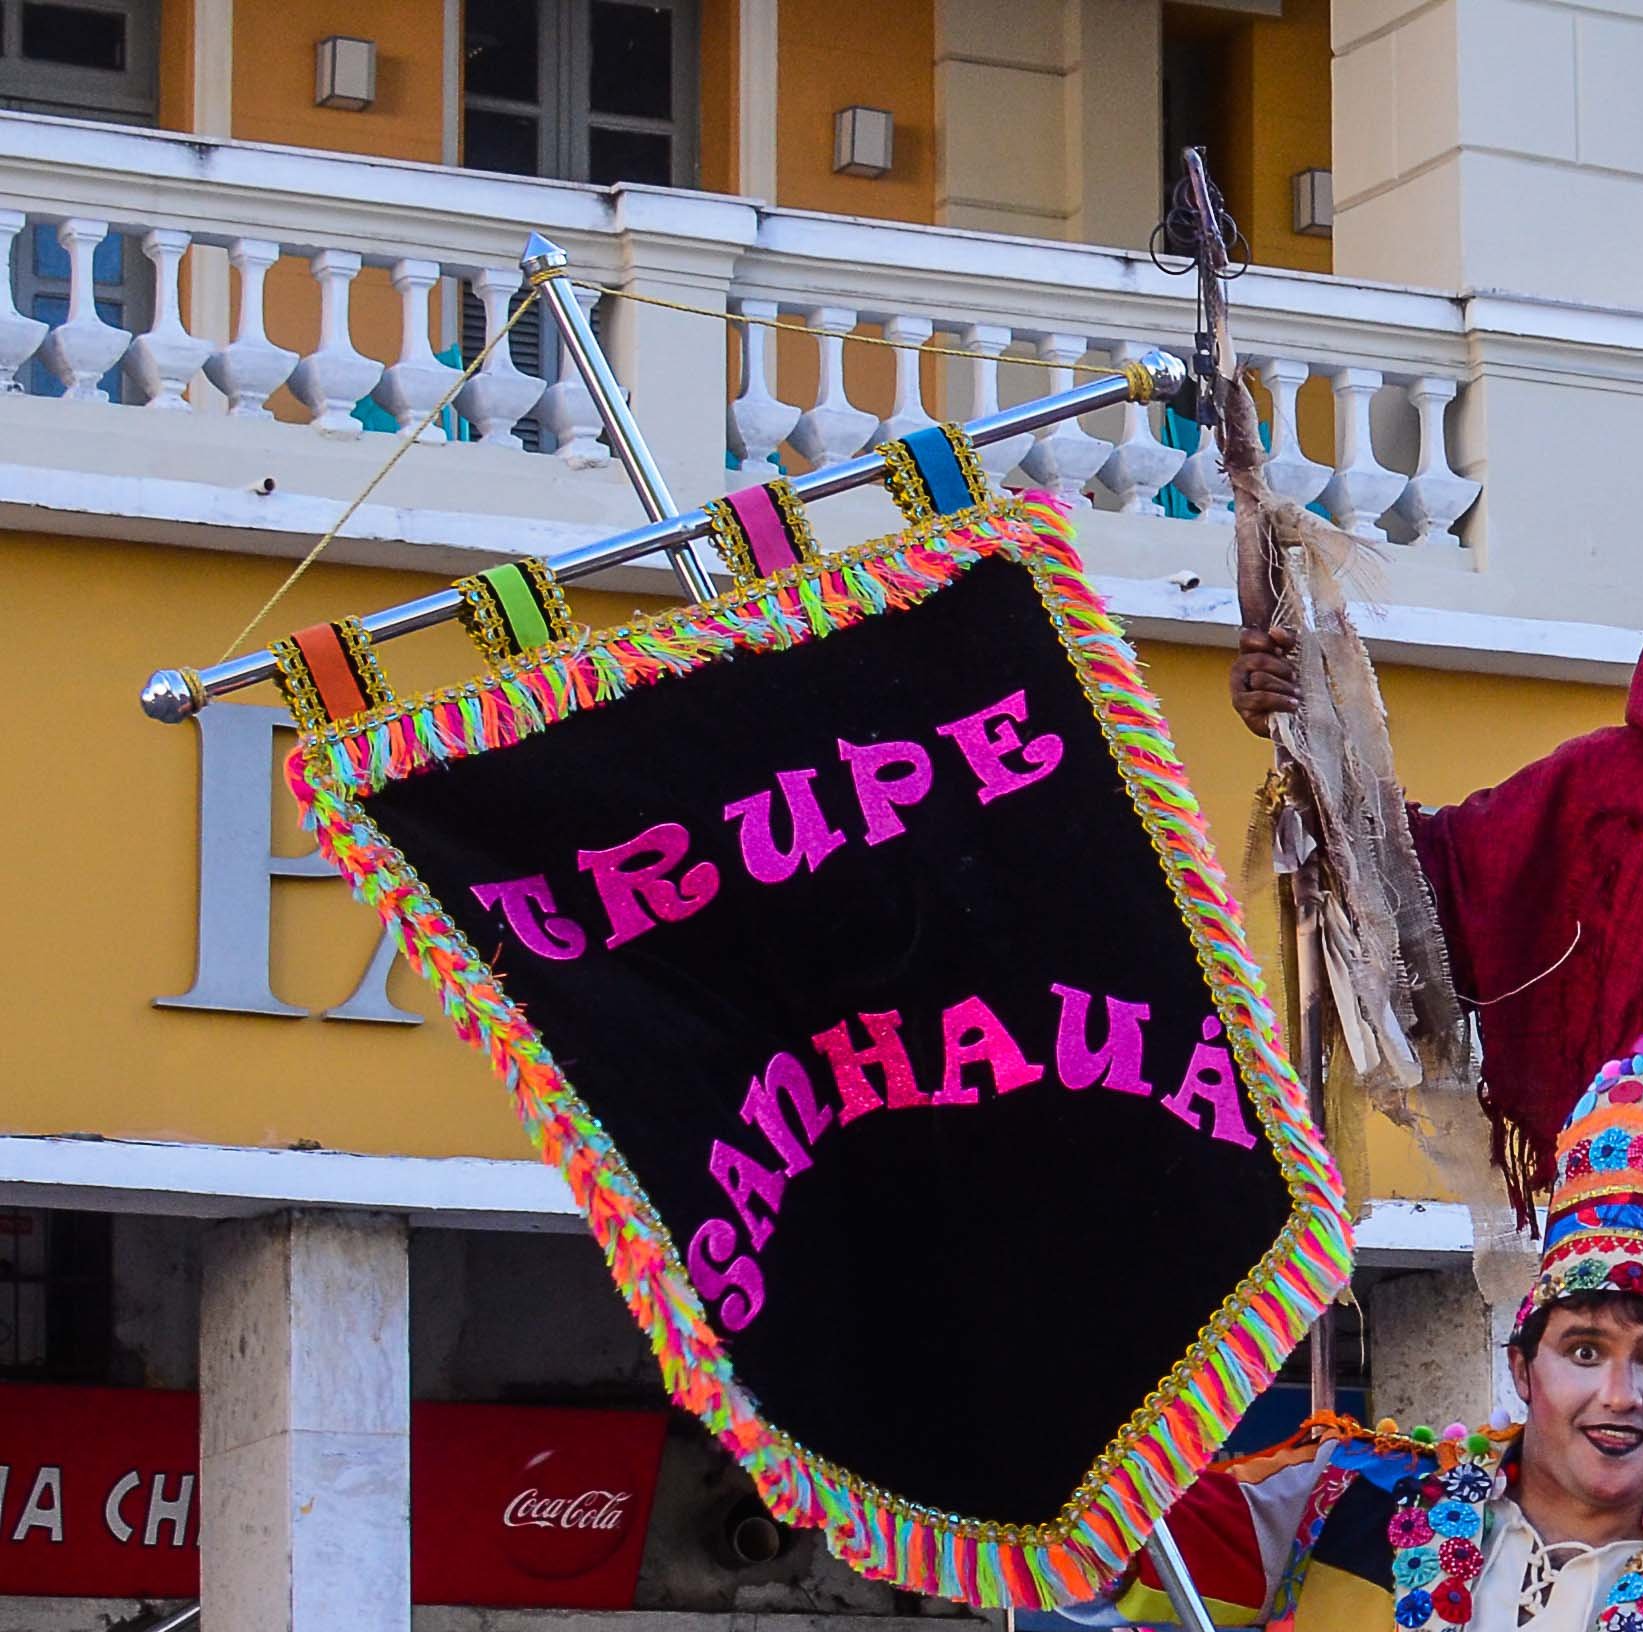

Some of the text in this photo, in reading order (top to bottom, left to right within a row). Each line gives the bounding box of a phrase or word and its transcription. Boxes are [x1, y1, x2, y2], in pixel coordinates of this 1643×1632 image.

[470, 689, 1064, 960] TRUPE
[688, 982, 1257, 1333] SANHAUÁ
[106, 1470, 201, 1546] CH
[503, 1488, 632, 1529] Coca-Cola
